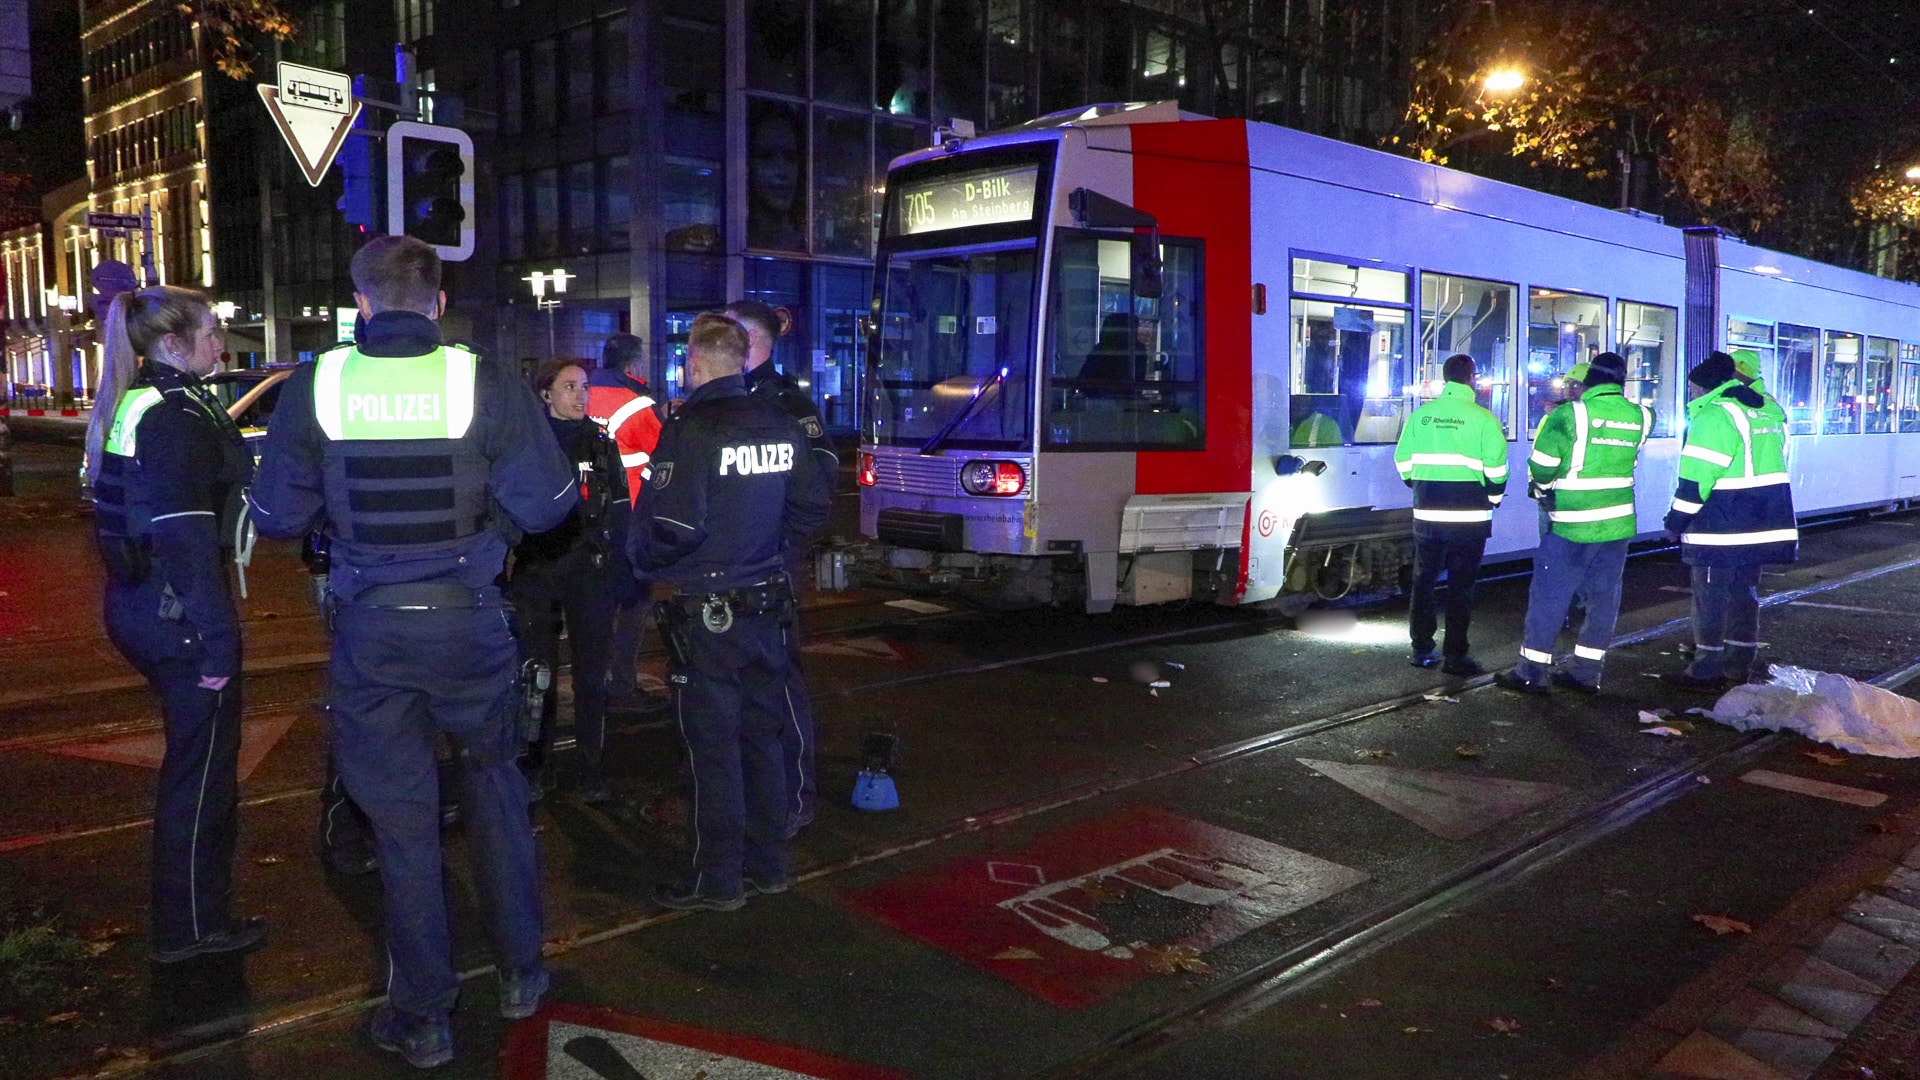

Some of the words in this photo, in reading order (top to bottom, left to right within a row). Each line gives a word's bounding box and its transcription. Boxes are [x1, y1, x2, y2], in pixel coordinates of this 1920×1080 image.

[965, 178, 1011, 201] D-Bilk
[905, 191, 936, 227] 705
[952, 208, 967, 221] Am
[972, 200, 1030, 219] Steinberg
[347, 393, 440, 421] POLIZEI
[719, 443, 794, 476] POLIZEI
